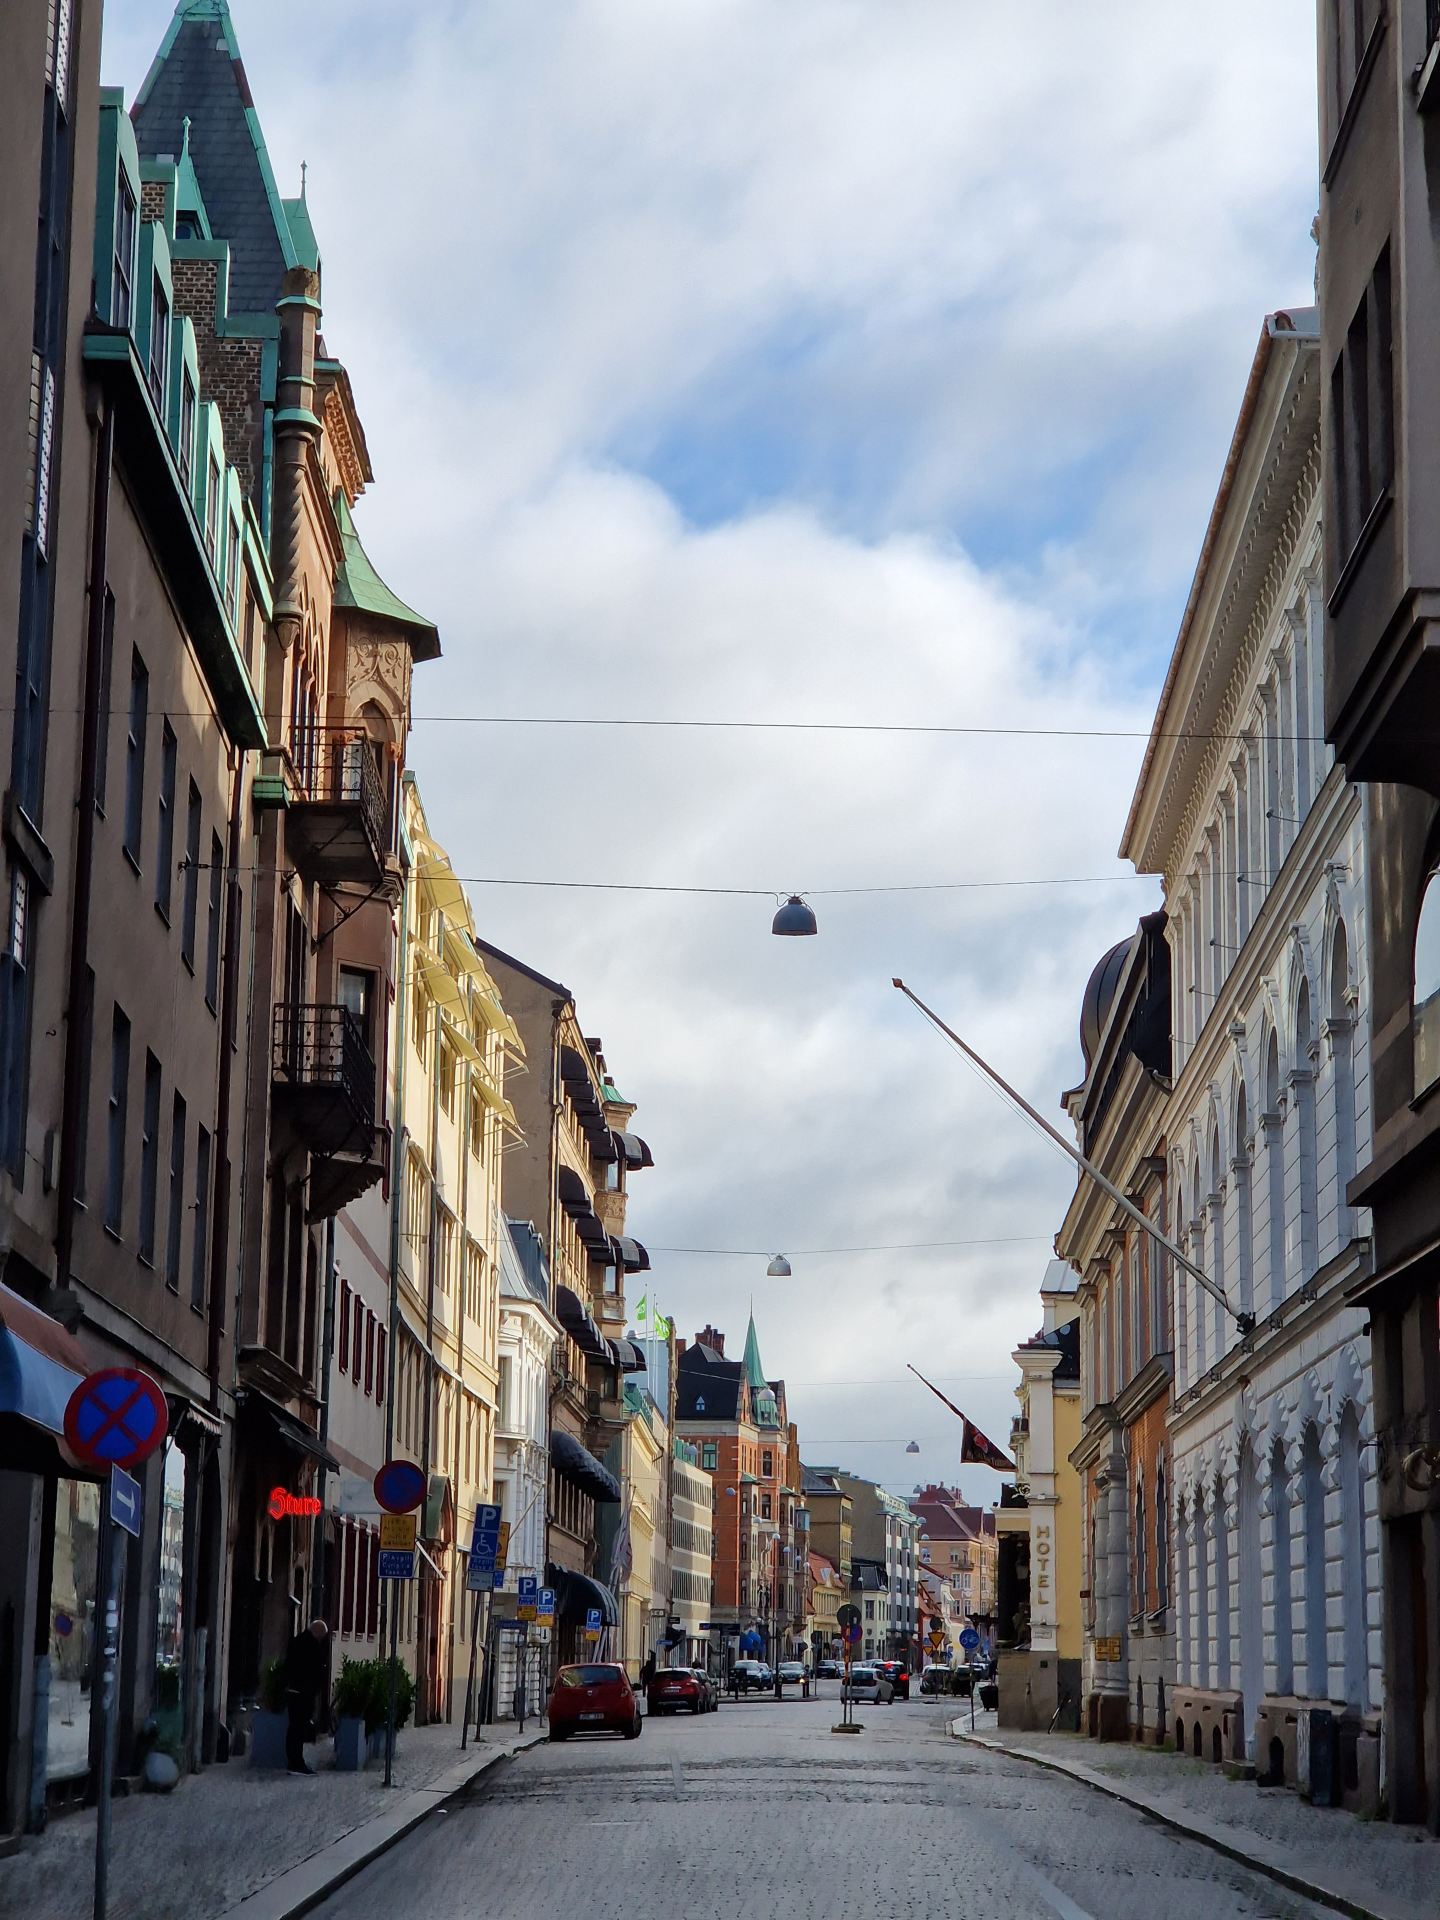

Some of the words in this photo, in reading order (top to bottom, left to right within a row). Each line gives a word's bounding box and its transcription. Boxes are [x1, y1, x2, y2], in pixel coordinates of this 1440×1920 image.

[270, 1487, 321, 1520] Sture
[481, 1507, 497, 1528] P
[1036, 1525, 1050, 1605] HOTEL
[523, 1578, 534, 1594] P
[542, 1591, 552, 1604] P
[590, 1610, 600, 1622] P
